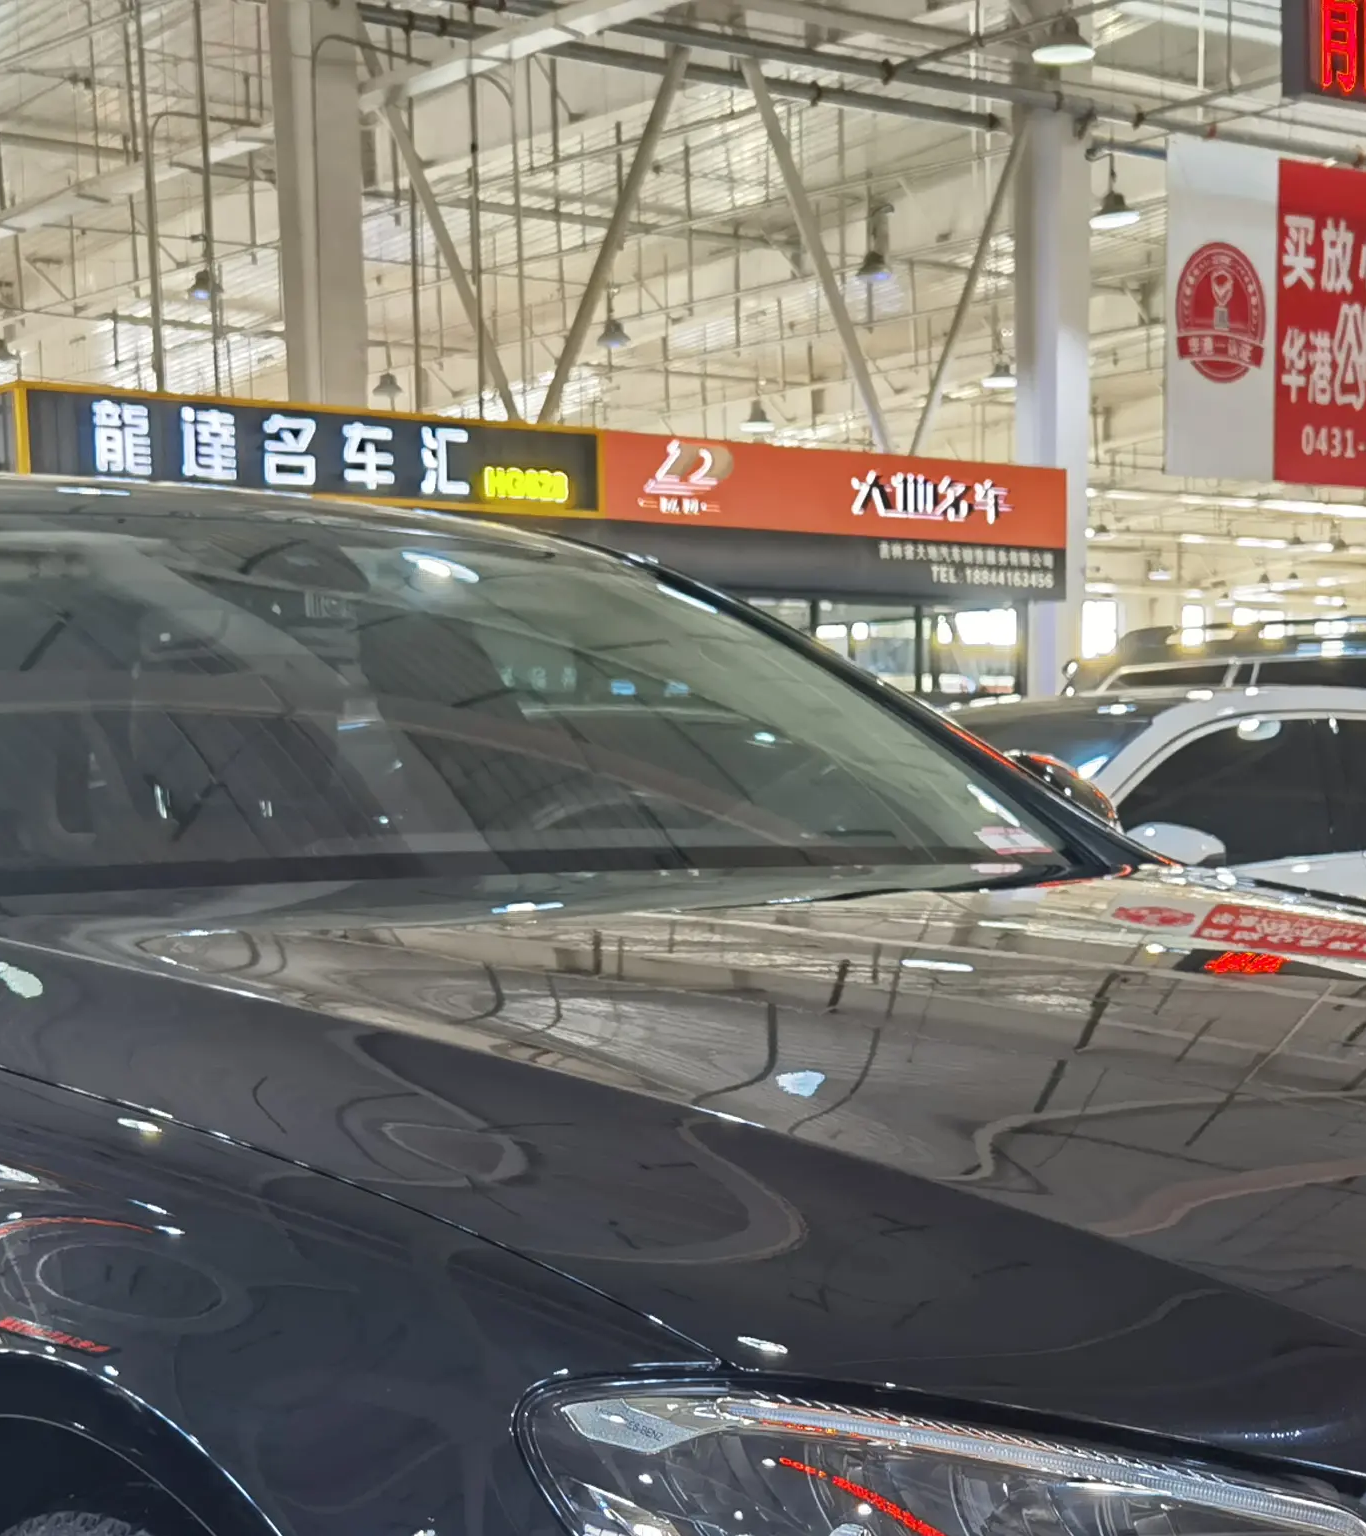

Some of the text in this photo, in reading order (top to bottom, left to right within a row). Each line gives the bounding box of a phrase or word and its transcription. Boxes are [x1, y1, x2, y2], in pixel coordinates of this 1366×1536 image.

[91, 400, 471, 496] 龍達名车汇
